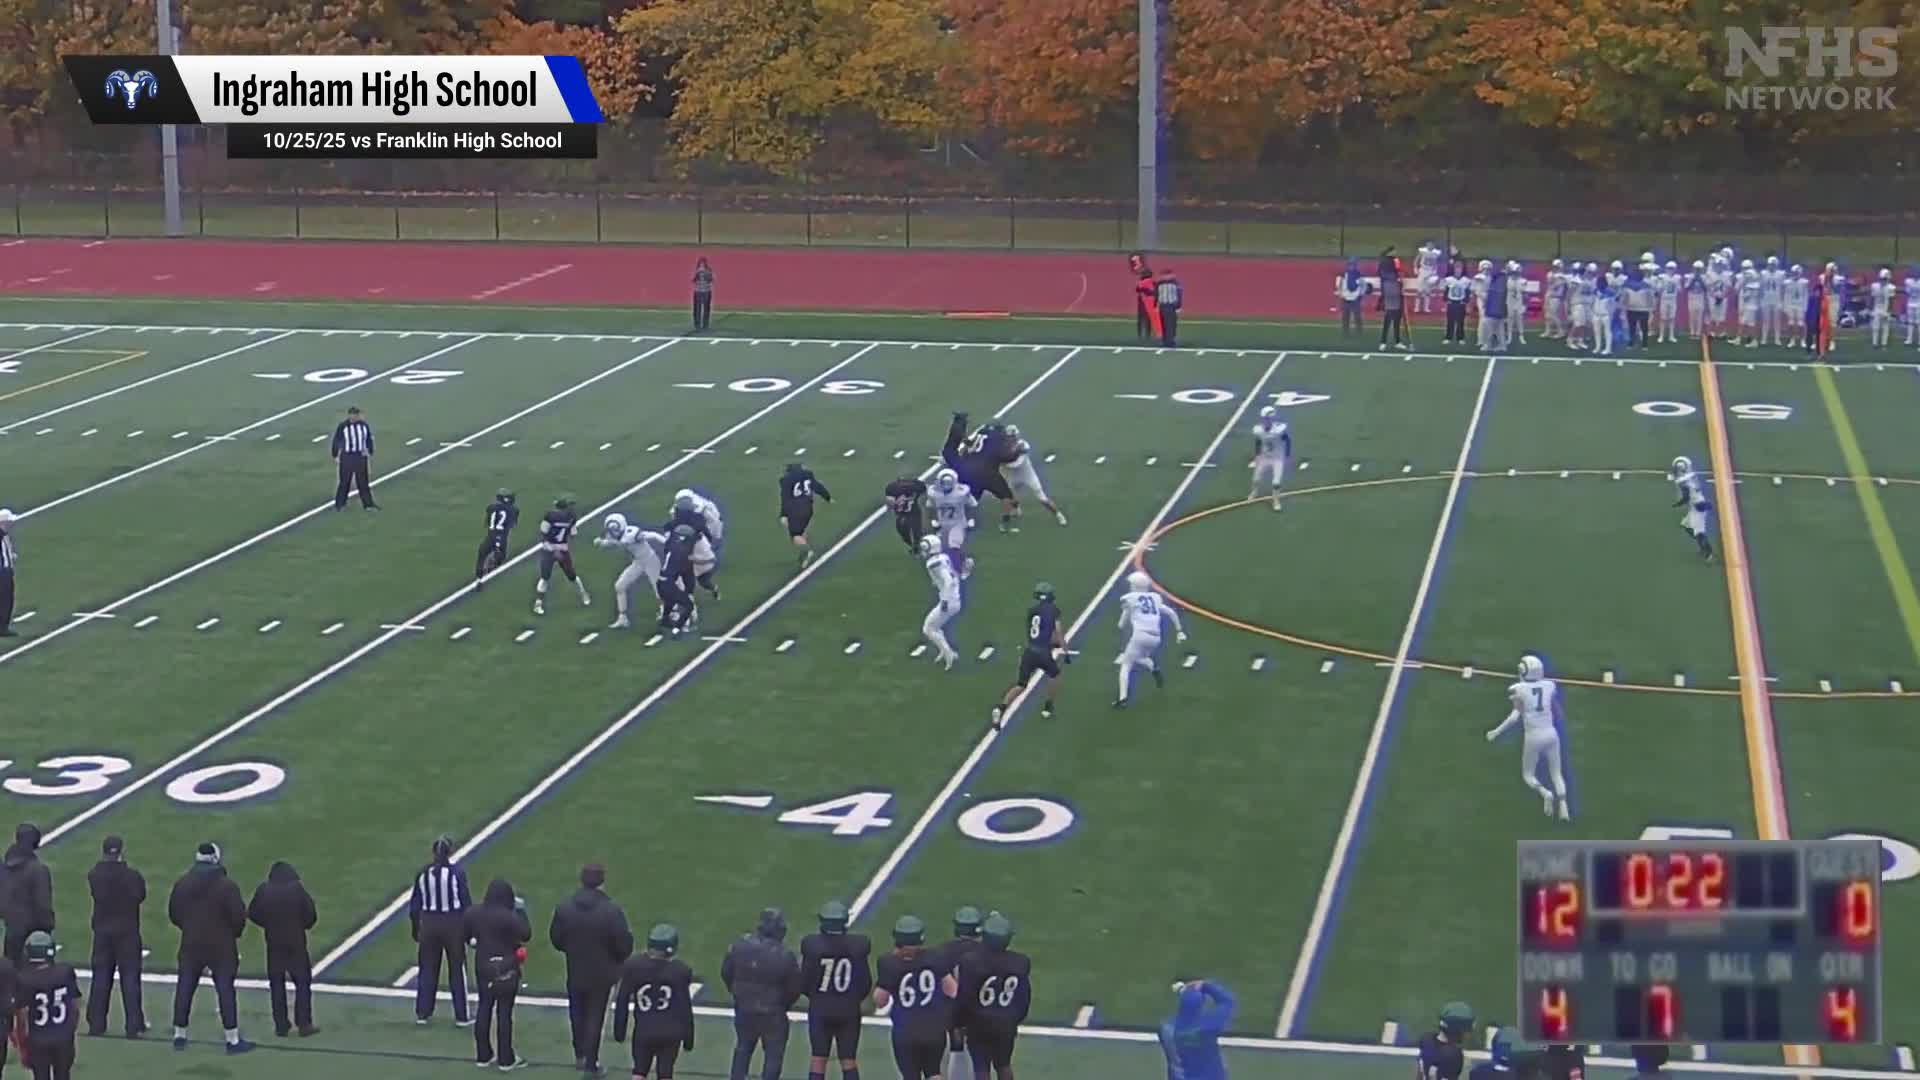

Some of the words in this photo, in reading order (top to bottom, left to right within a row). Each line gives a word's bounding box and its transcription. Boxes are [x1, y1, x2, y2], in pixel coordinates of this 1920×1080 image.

[488, 510, 508, 530] 12
[1138, 596, 1158, 616] 31
[1030, 615, 1041, 639] 8
[1532, 687, 1544, 712] 7
[819, 958, 852, 992] 70
[900, 969, 935, 1007] 69
[637, 984, 672, 1012] 63
[979, 976, 1018, 1007] 68
[34, 986, 68, 1027] 35
